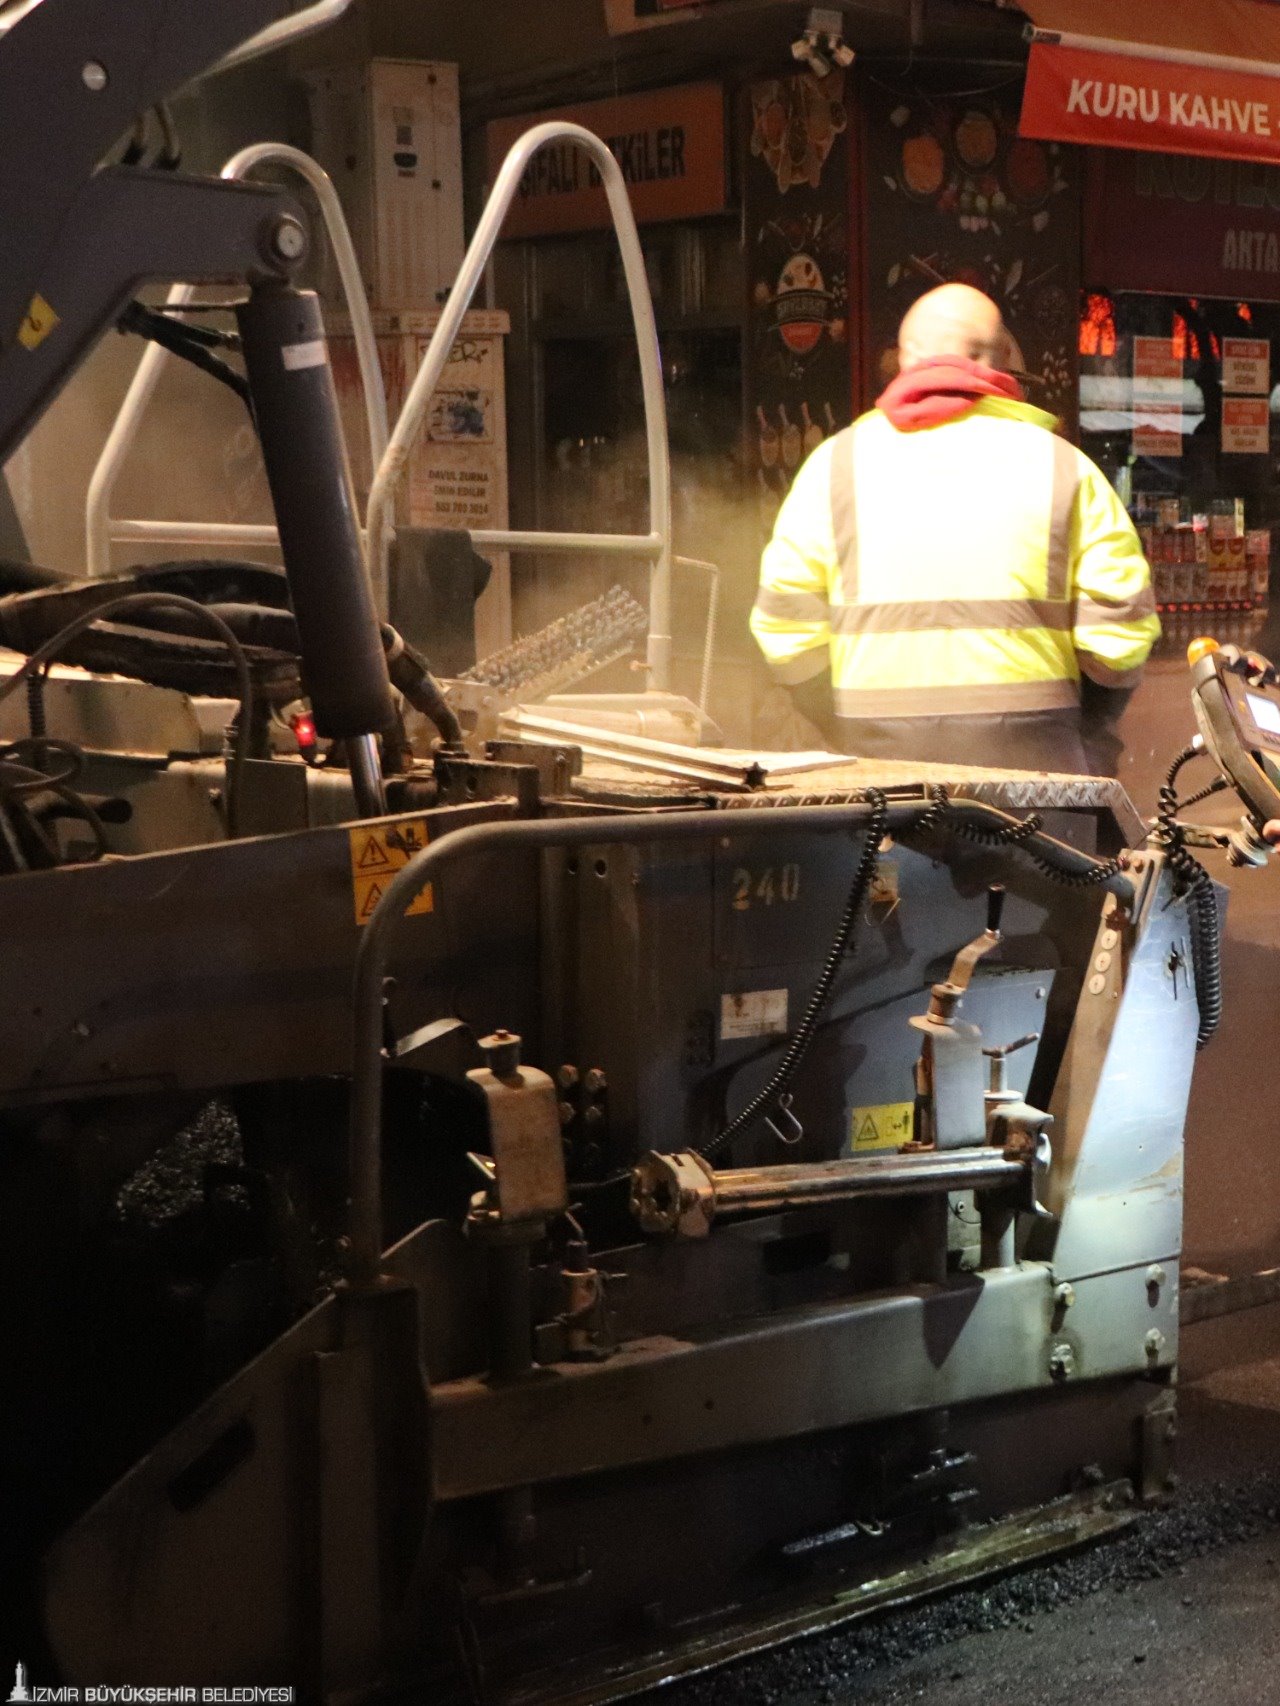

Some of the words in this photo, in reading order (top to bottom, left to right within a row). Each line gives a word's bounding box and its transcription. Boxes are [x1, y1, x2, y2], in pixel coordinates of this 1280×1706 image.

[1066, 78, 1160, 123] KURU
[1168, 91, 1271, 137] KAHVE
[732, 863, 800, 911] 240
